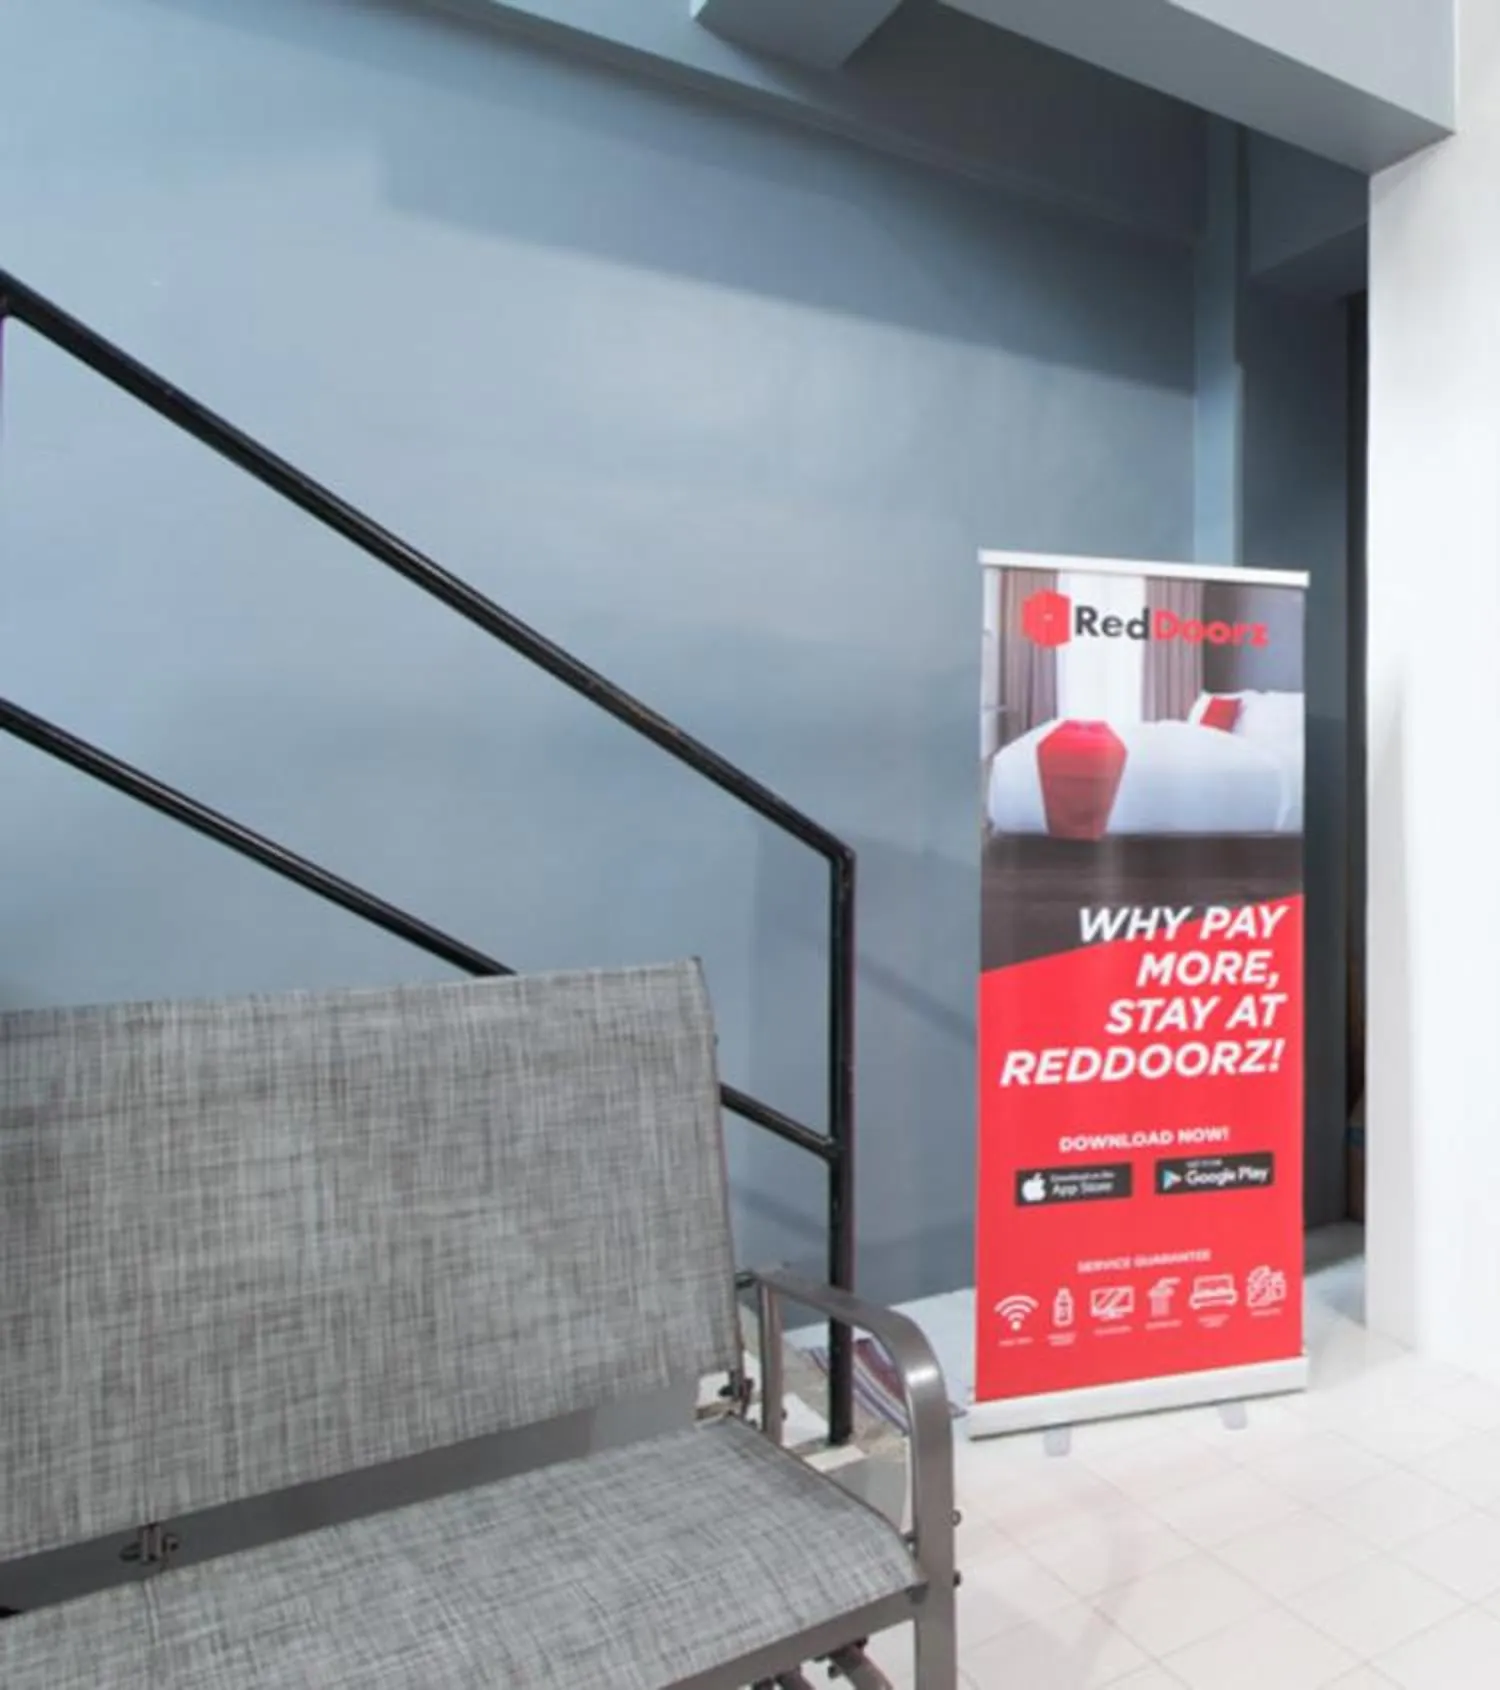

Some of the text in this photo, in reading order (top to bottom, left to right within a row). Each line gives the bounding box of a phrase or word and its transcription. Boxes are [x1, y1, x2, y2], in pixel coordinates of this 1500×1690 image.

[1075, 605, 1268, 647] RedDoorz
[1079, 904, 1289, 943] WHY PAY
[1135, 949, 1280, 989] MORE,
[1104, 993, 1288, 1035] STAY AT
[999, 1038, 1286, 1087] REDDOORZ!
[1058, 1126, 1231, 1153] DOWNLOAD NOW!
[1051, 1180, 1115, 1198] App Store
[1184, 1164, 1270, 1187] Google Play
